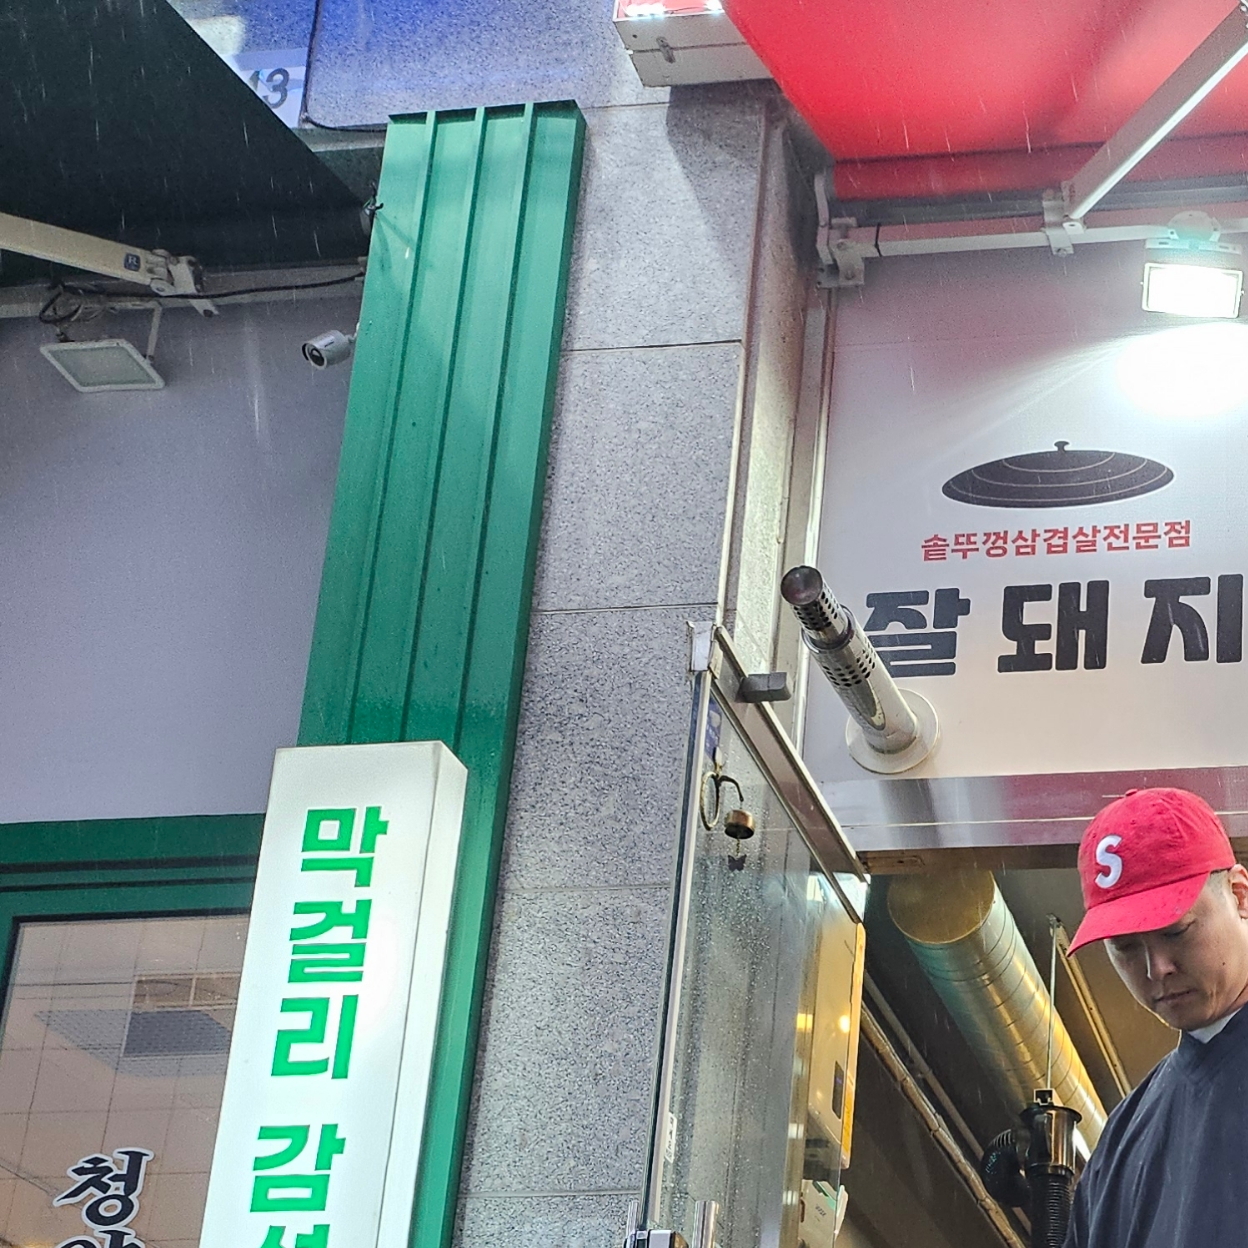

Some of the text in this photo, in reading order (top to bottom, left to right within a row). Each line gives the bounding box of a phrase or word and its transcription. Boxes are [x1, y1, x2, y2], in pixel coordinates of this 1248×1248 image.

[921, 520, 1191, 561] 솥뚜껑삼겹살전문점
[864, 574, 1243, 677] 잘돼지
[1095, 835, 1123, 889] S
[270, 805, 388, 1081] 막걸리
